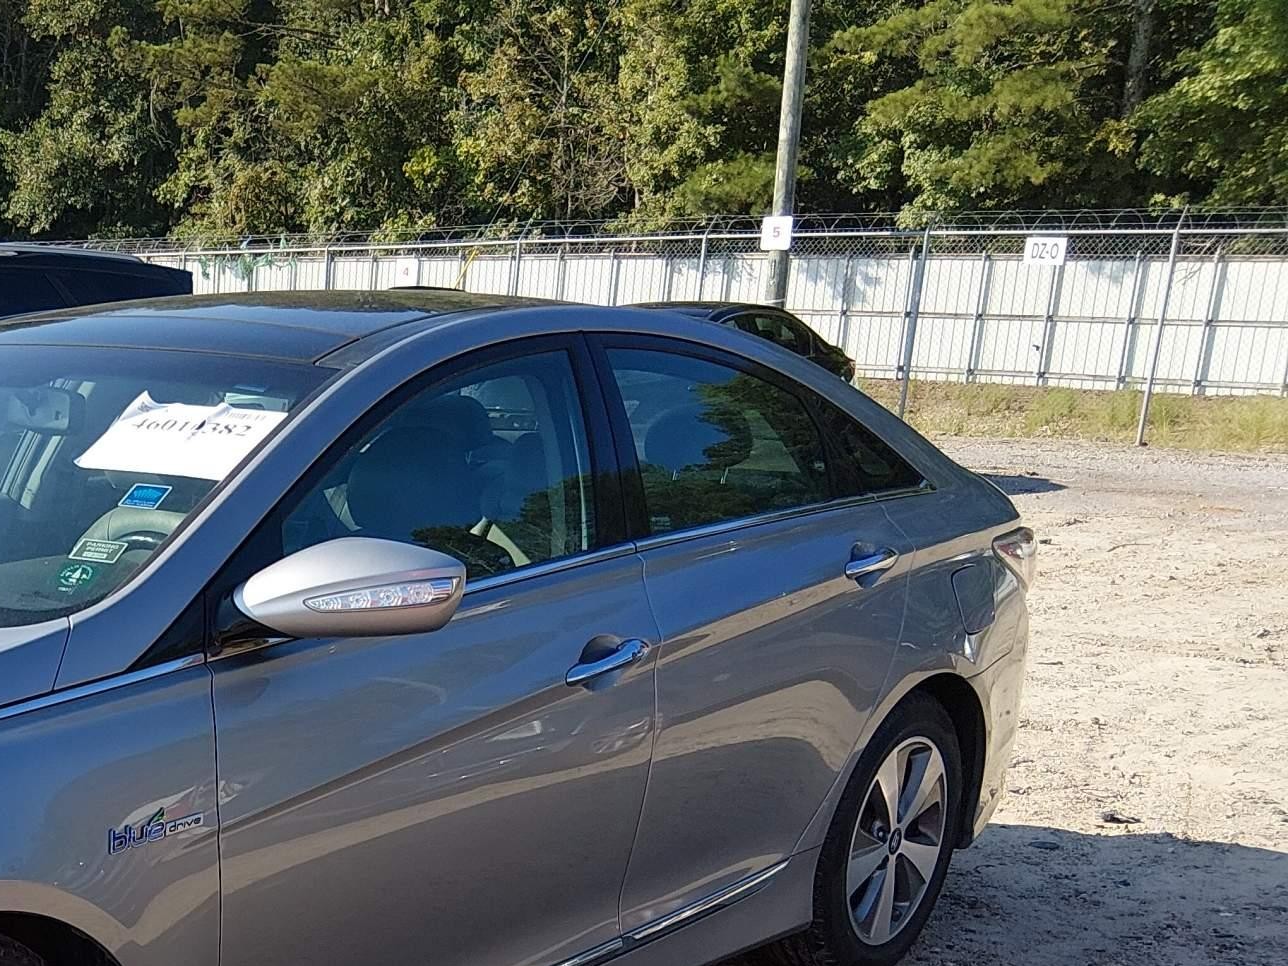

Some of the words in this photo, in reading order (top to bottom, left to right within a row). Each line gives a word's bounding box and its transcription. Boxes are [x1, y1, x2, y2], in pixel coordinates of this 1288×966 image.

[772, 226, 781, 238] 5
[108, 819, 165, 855] blue
[168, 817, 202, 832] drive
